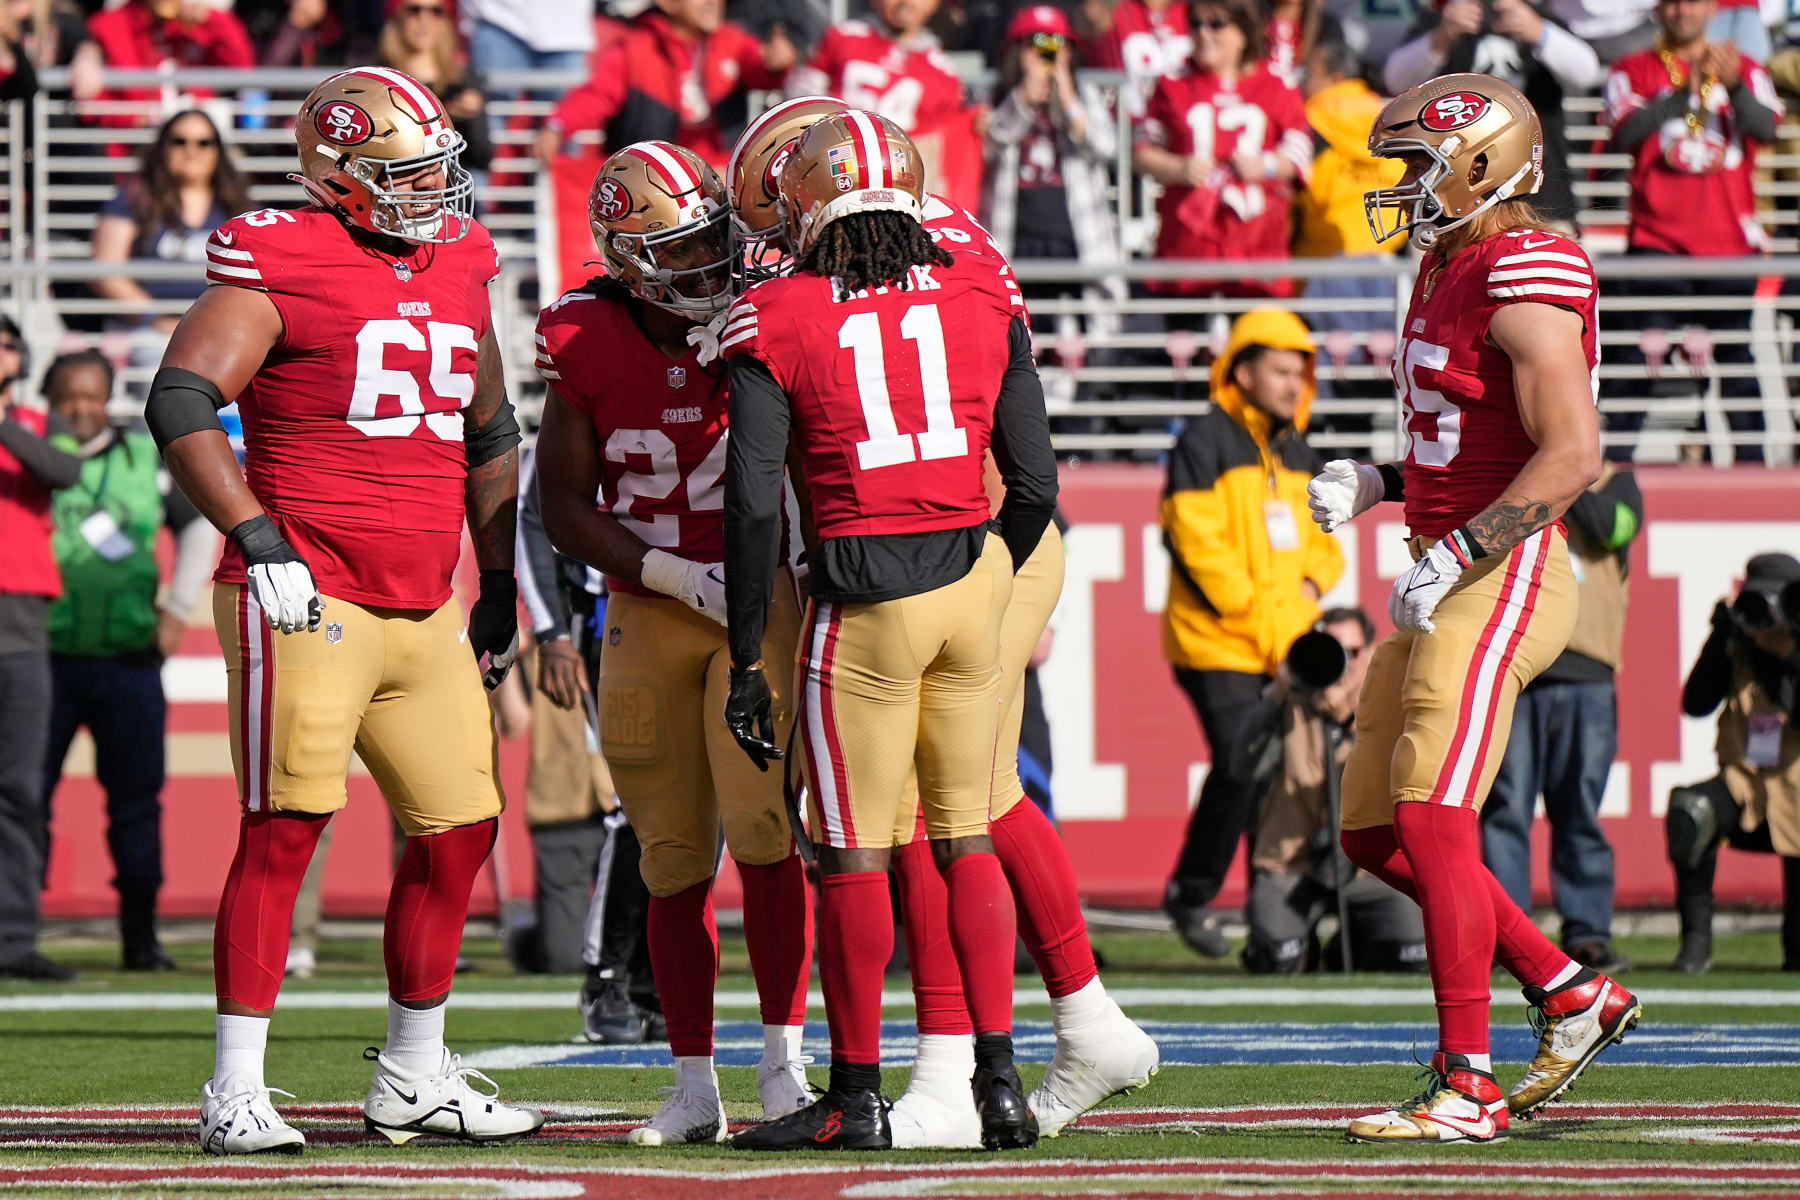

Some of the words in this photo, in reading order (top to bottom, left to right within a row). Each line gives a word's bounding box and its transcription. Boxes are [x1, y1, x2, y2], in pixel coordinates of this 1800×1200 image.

[1435, 95, 1481, 128] SF
[860, 191, 895, 203] 49ERS
[397, 301, 432, 317] 49ERS
[346, 319, 479, 442] 65
[838, 304, 969, 470] 11
[661, 406, 703, 424] 49ERS
[605, 428, 730, 547] 24
